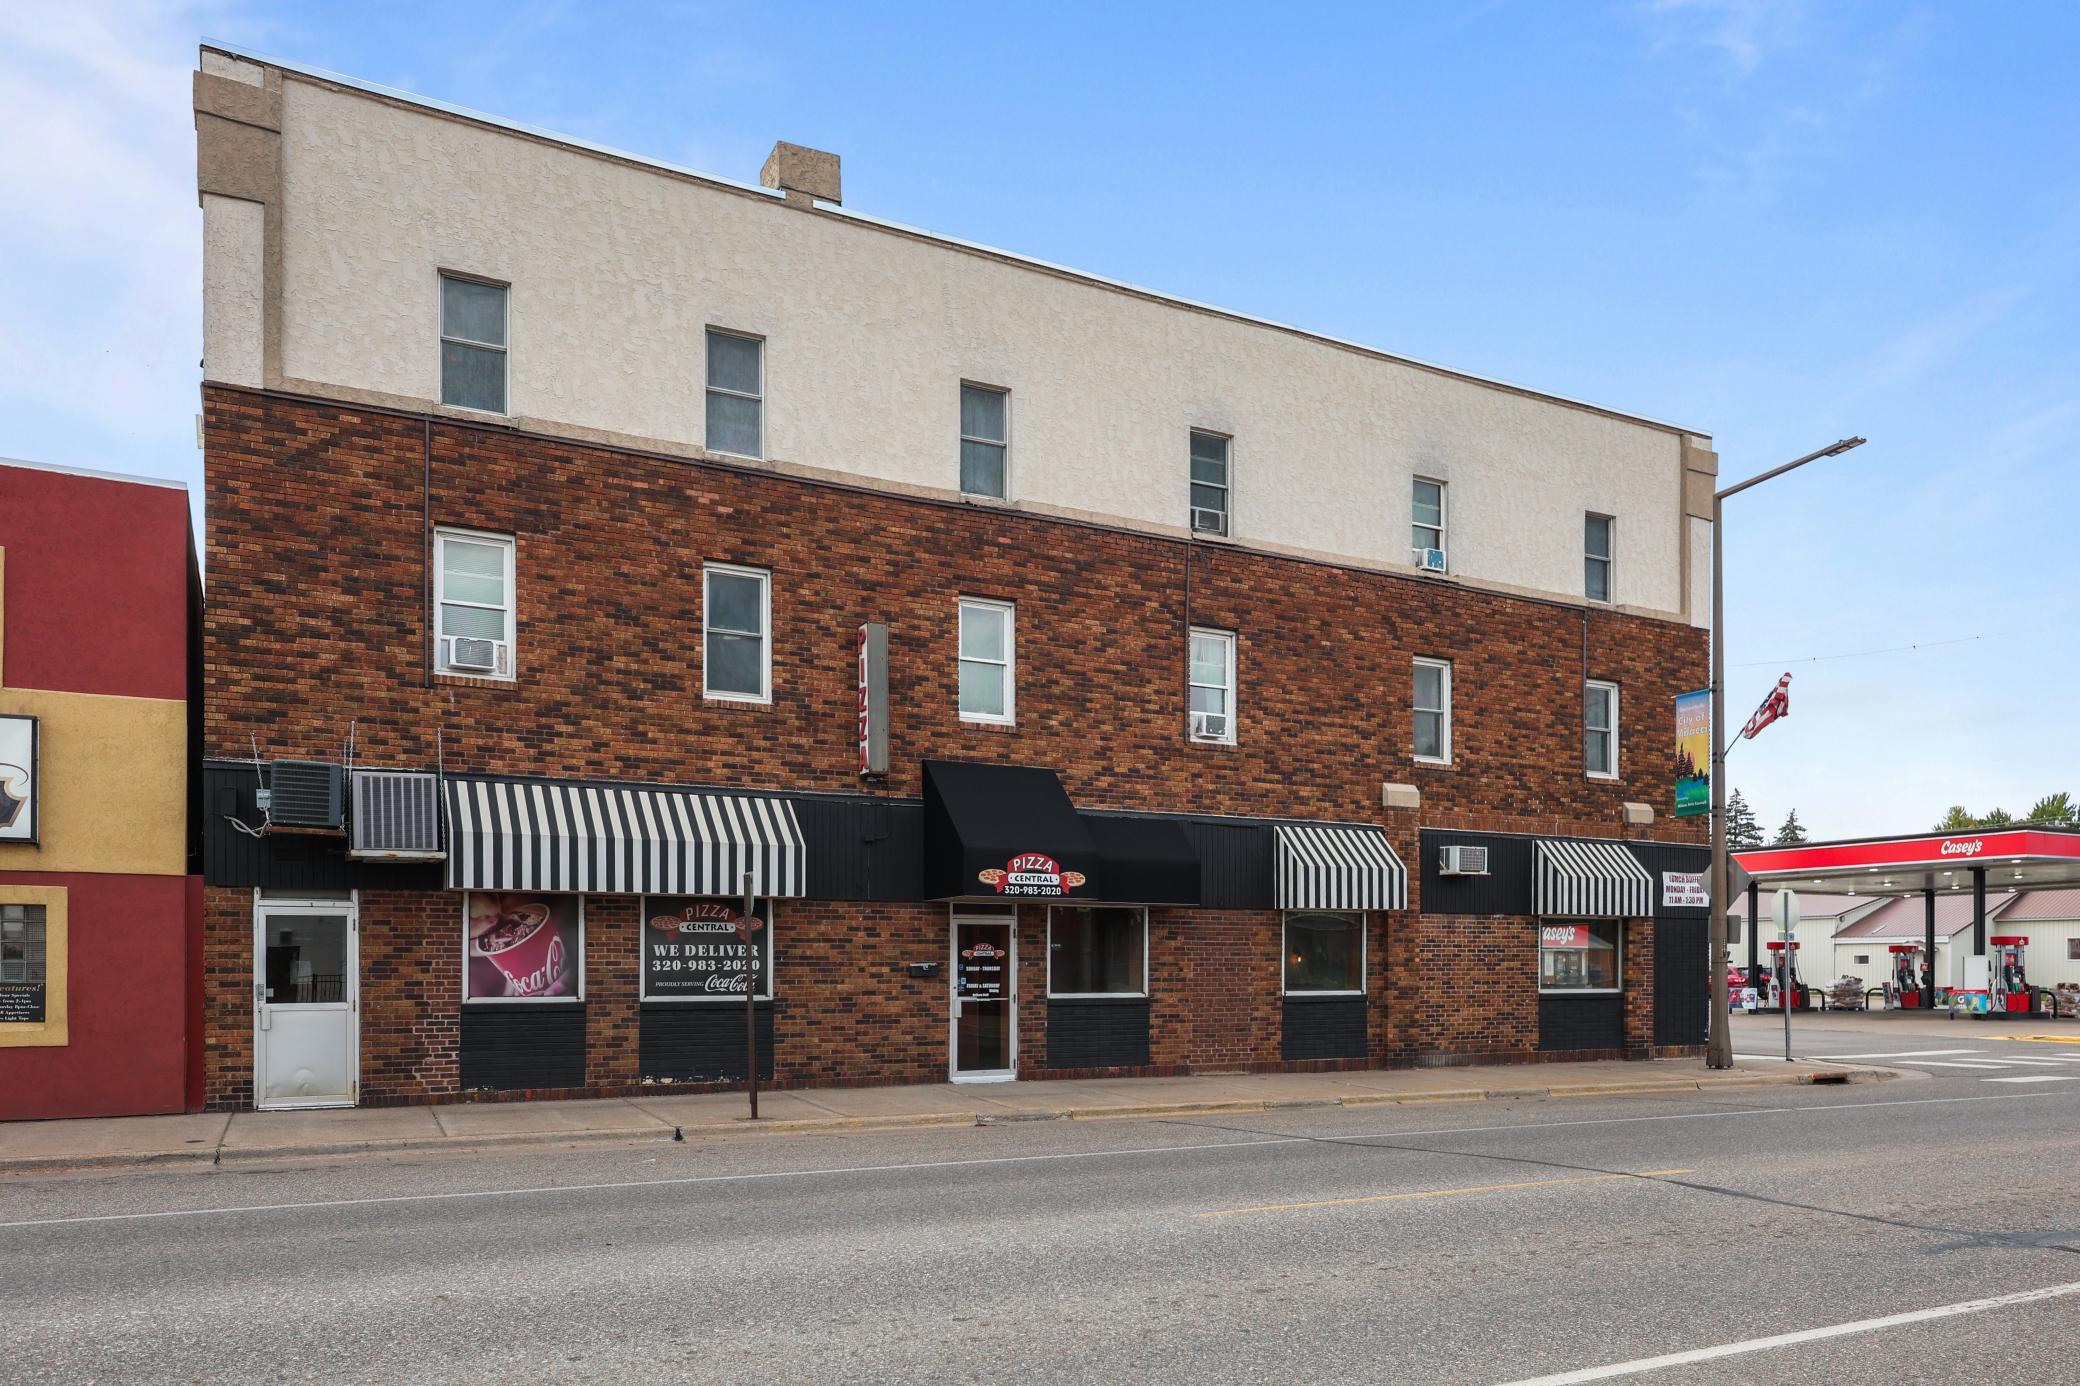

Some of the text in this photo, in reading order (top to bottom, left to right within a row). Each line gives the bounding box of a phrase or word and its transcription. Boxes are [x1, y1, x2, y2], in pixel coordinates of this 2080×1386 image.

[857, 628, 868, 771] PIZZA
[1941, 839, 1982, 856] Casey's
[1013, 856, 1053, 872] PIZZA
[1014, 875, 1054, 883] CENTRAL
[1686, 875, 1702, 883] BUFFE
[1004, 886, 1061, 895] 320-983-2020
[686, 904, 730, 920] PIZZA
[686, 923, 729, 931] CENTRAL
[1542, 926, 1575, 945] asey's
[653, 944, 759, 957] WE DELIVER
[704, 974, 757, 992] Coca-Col
